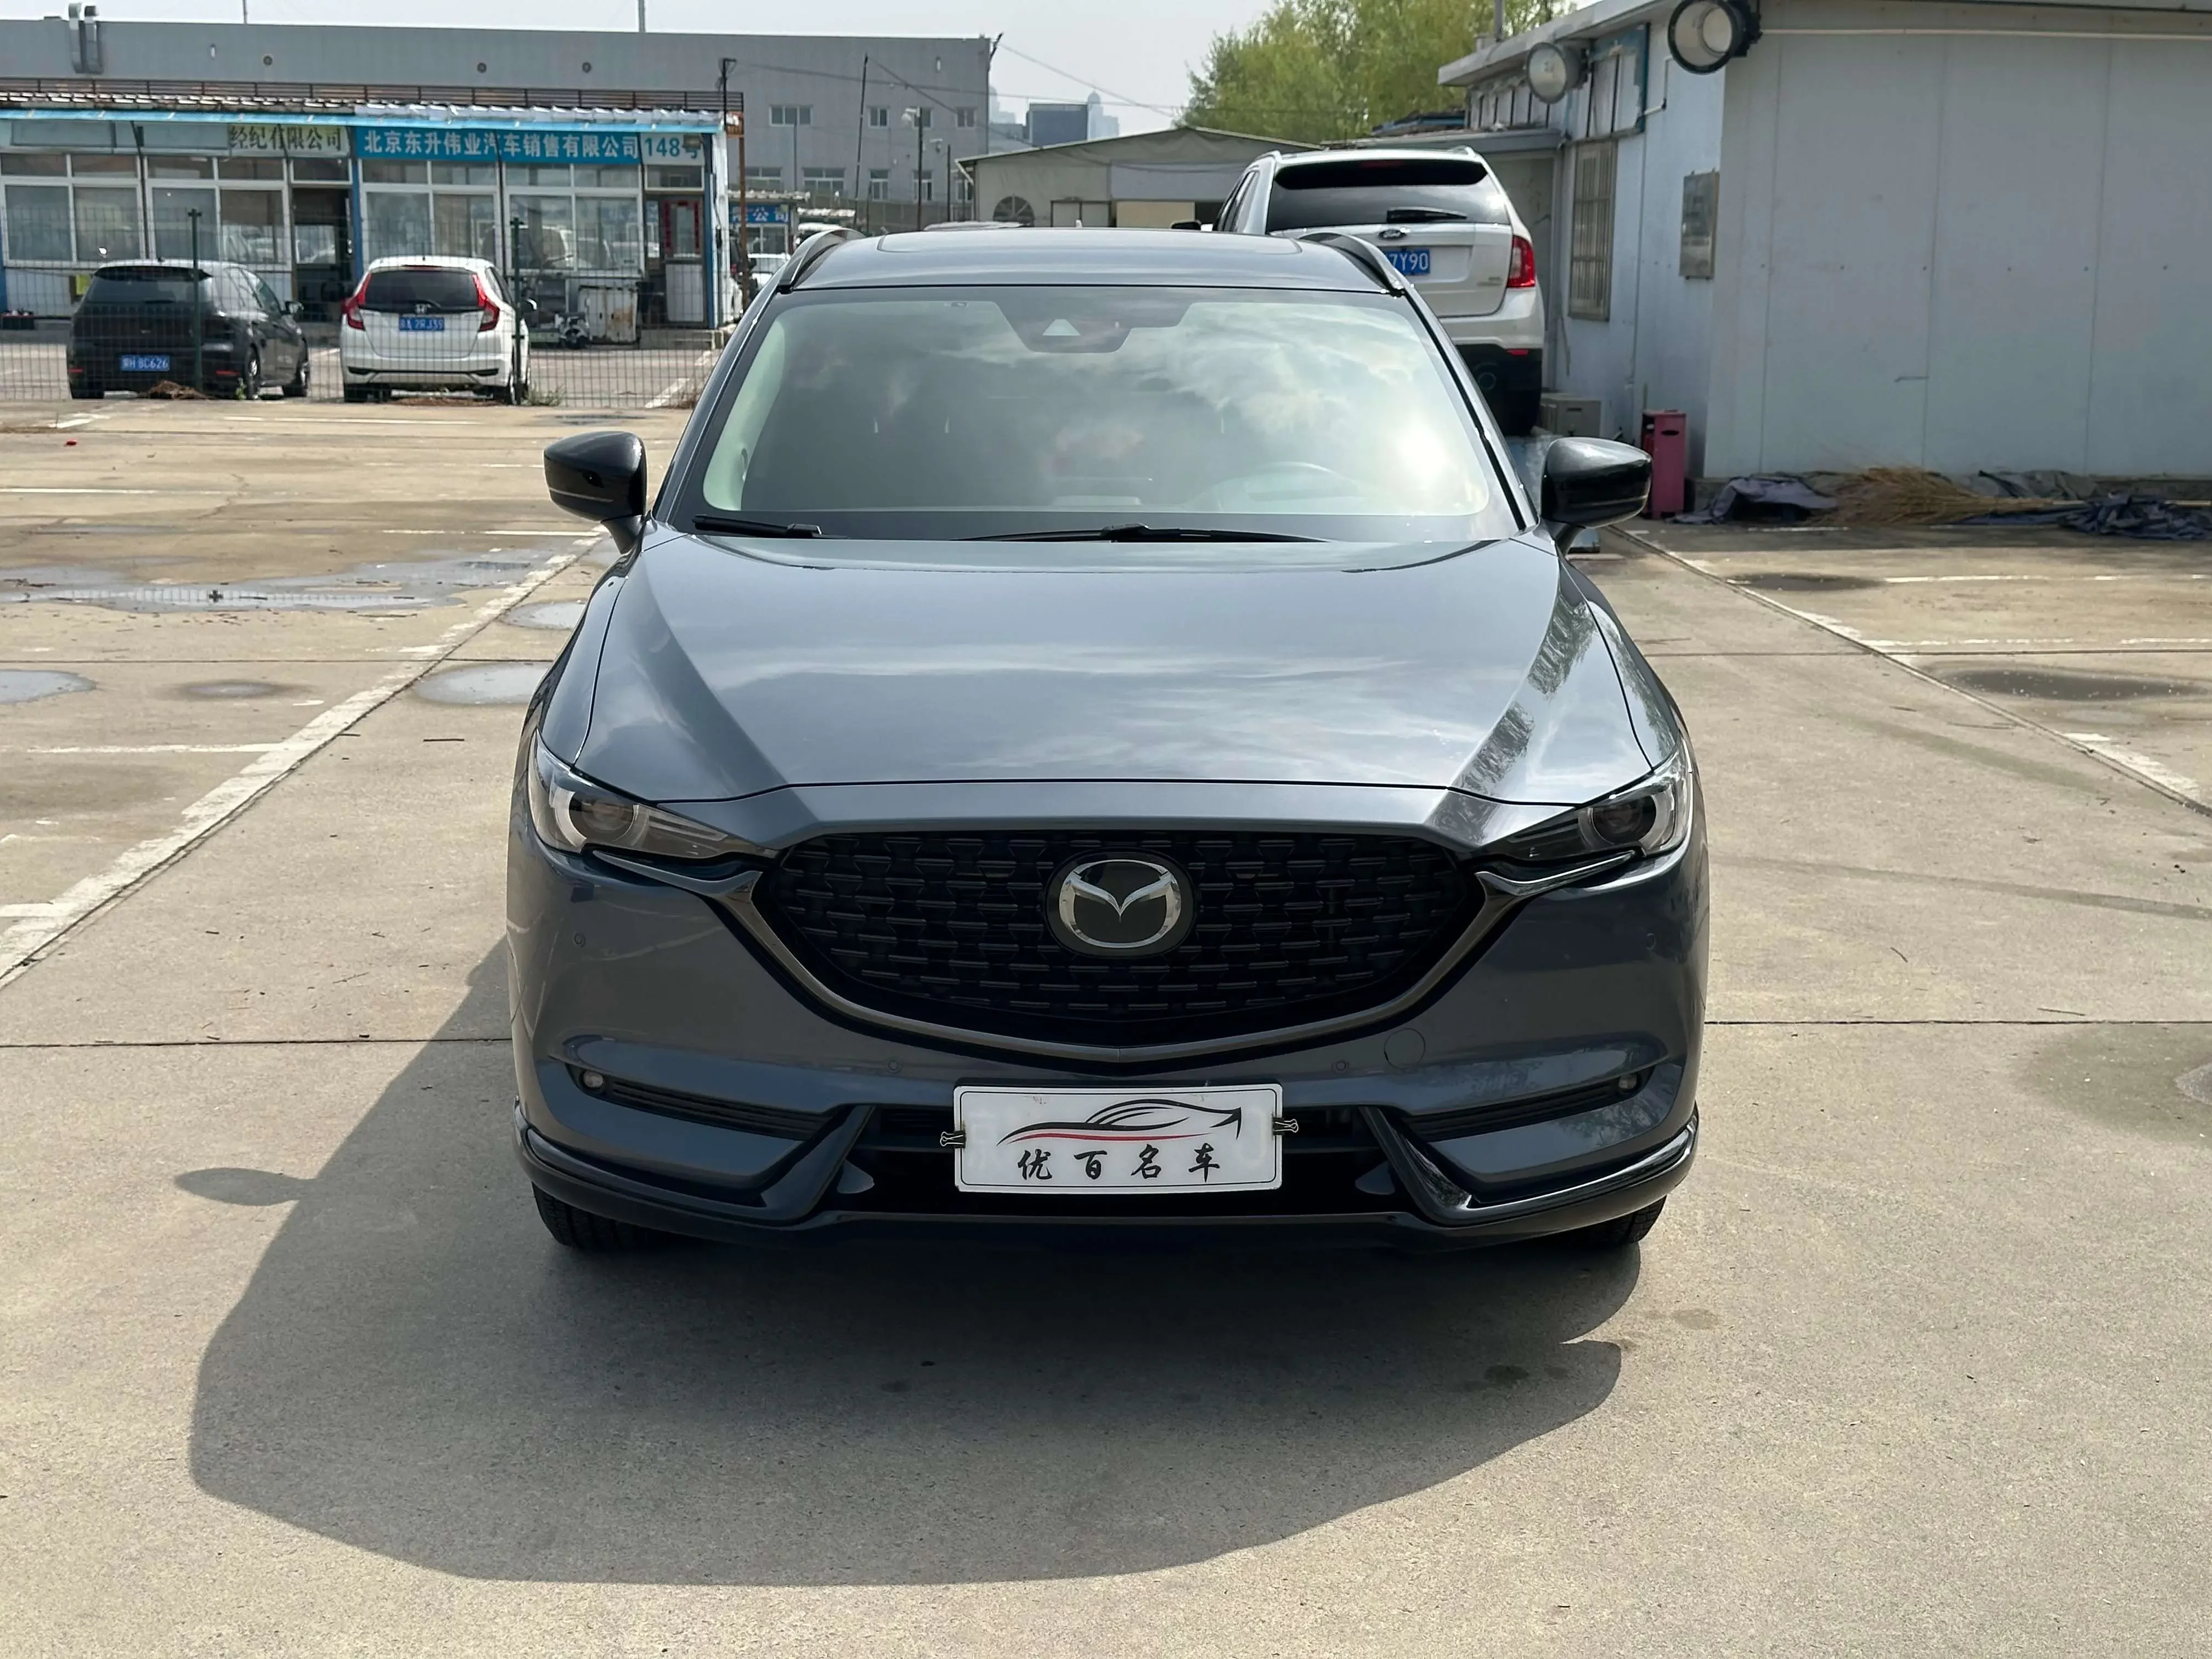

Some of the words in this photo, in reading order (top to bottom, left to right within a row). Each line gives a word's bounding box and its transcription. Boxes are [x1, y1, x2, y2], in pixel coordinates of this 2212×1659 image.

[364, 131, 639, 159] 北京东升伟业汽车销售有限公司
[1018, 1143, 1220, 1183] 优百名车
